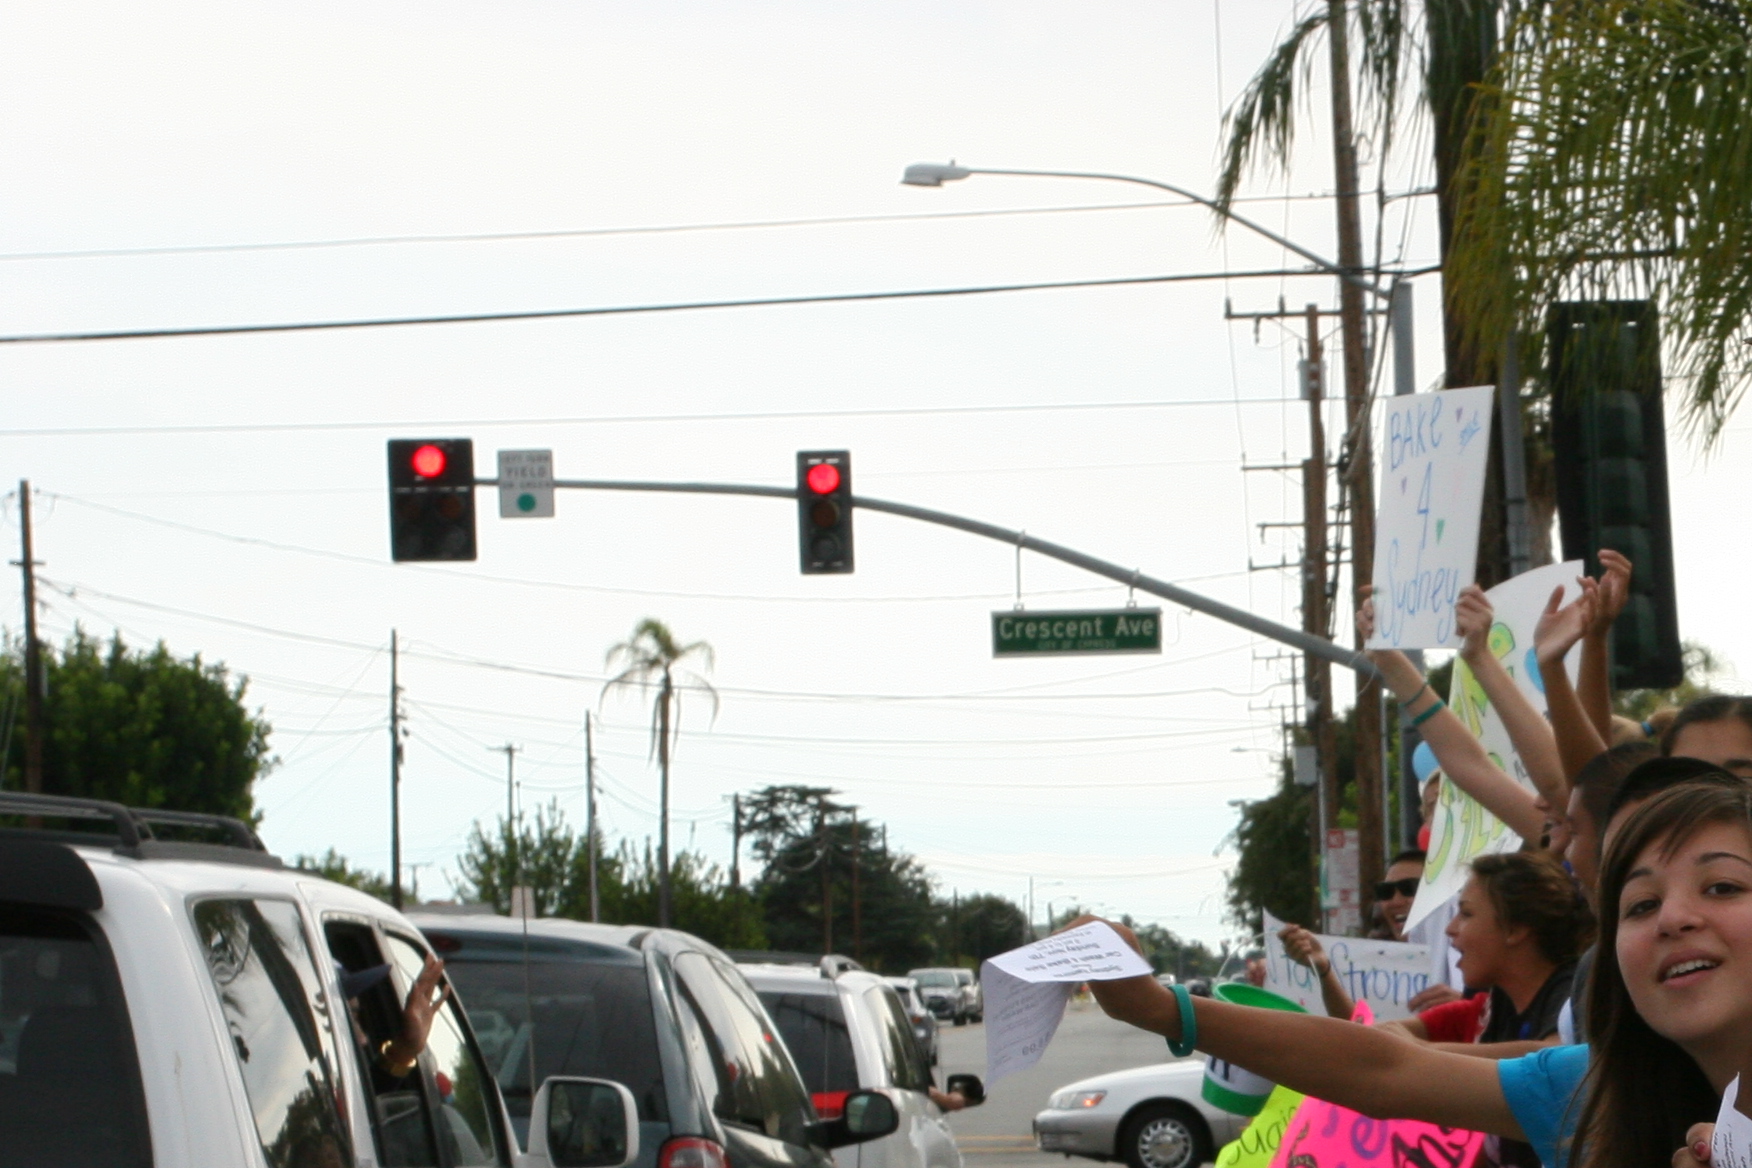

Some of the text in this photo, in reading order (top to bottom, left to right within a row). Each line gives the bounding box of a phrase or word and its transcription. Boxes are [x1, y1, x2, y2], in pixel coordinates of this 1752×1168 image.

[504, 465, 548, 479] YIELD
[1417, 461, 1432, 550] 4
[1380, 537, 1460, 647] Sydney
[1000, 615, 1154, 639] Crescent Ave
